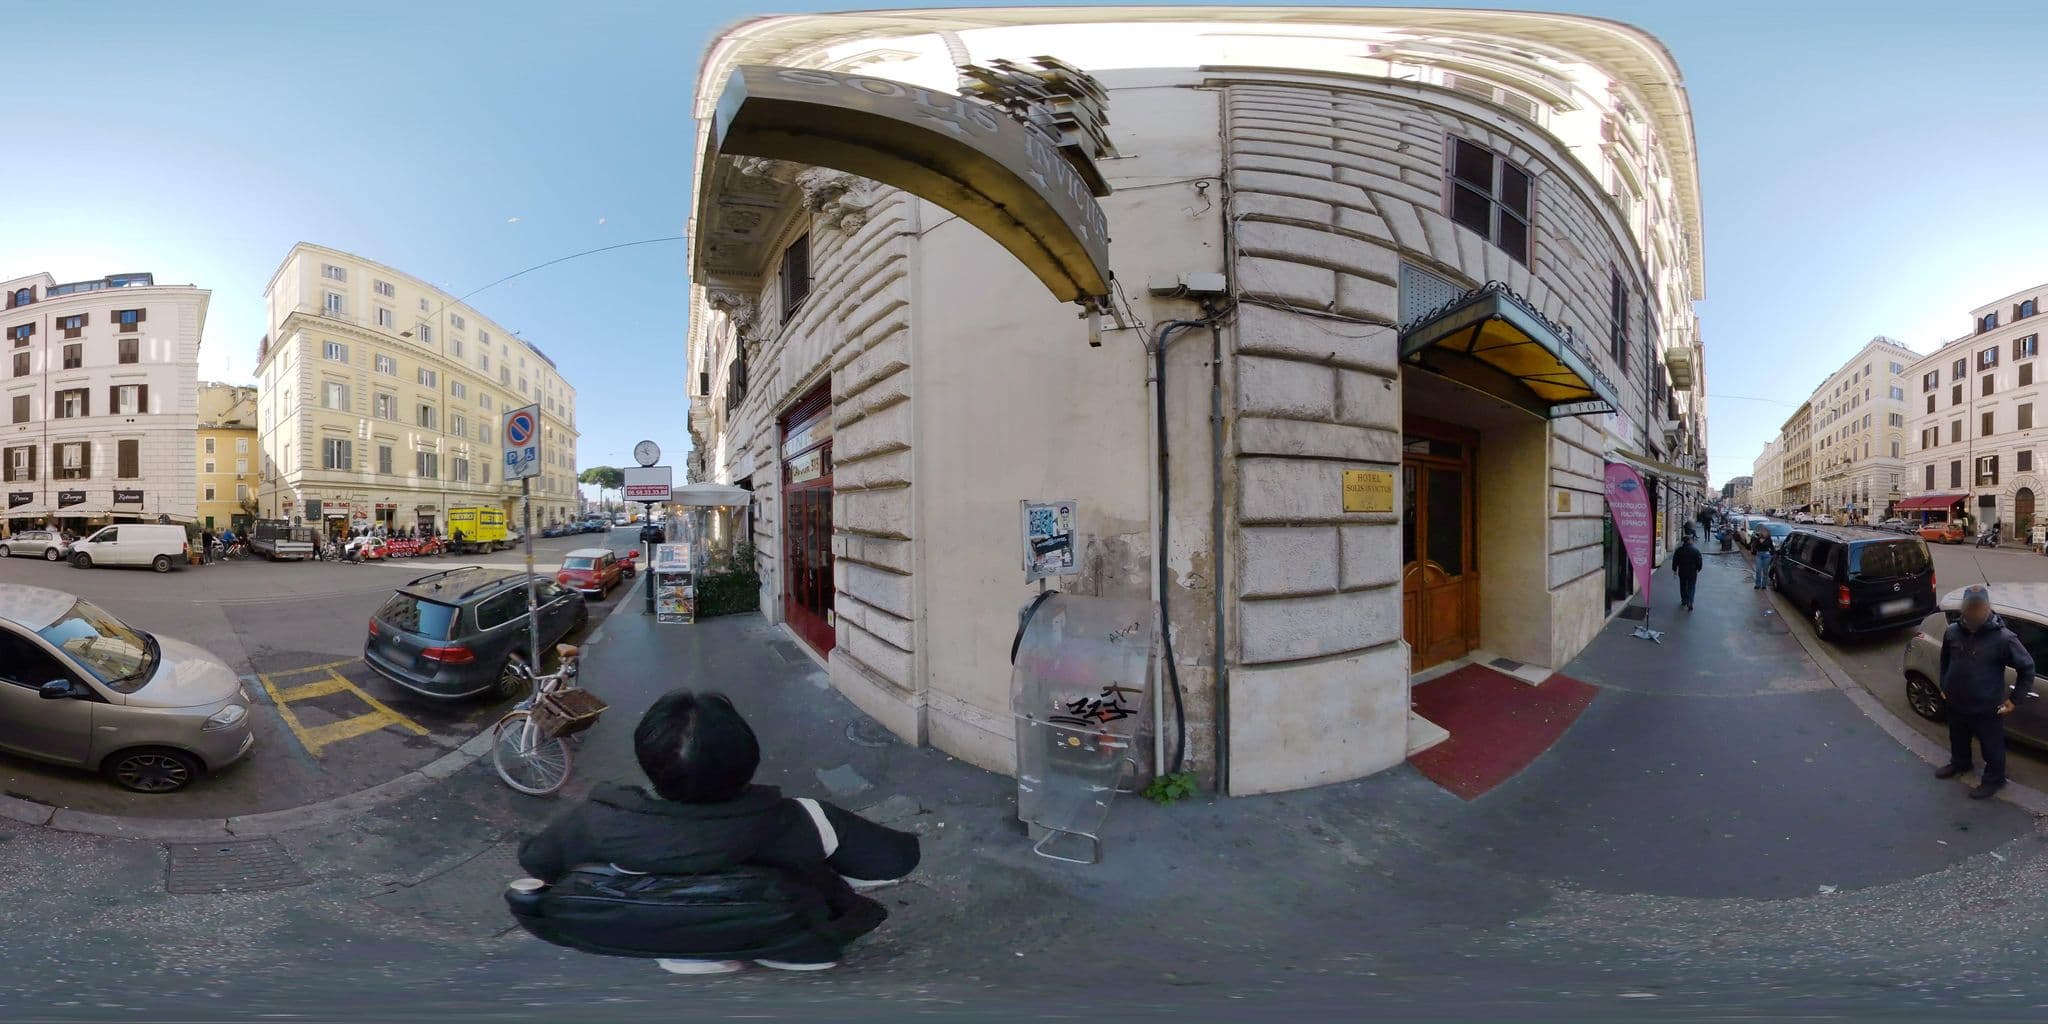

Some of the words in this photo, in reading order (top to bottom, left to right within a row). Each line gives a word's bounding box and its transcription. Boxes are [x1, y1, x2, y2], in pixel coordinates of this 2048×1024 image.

[776, 69, 999, 133] SOLIS
[1023, 129, 1106, 246] INVICTUS
[509, 452, 517, 464] P
[1357, 473, 1382, 483] HOTEL
[1346, 484, 1364, 492] SOLIS
